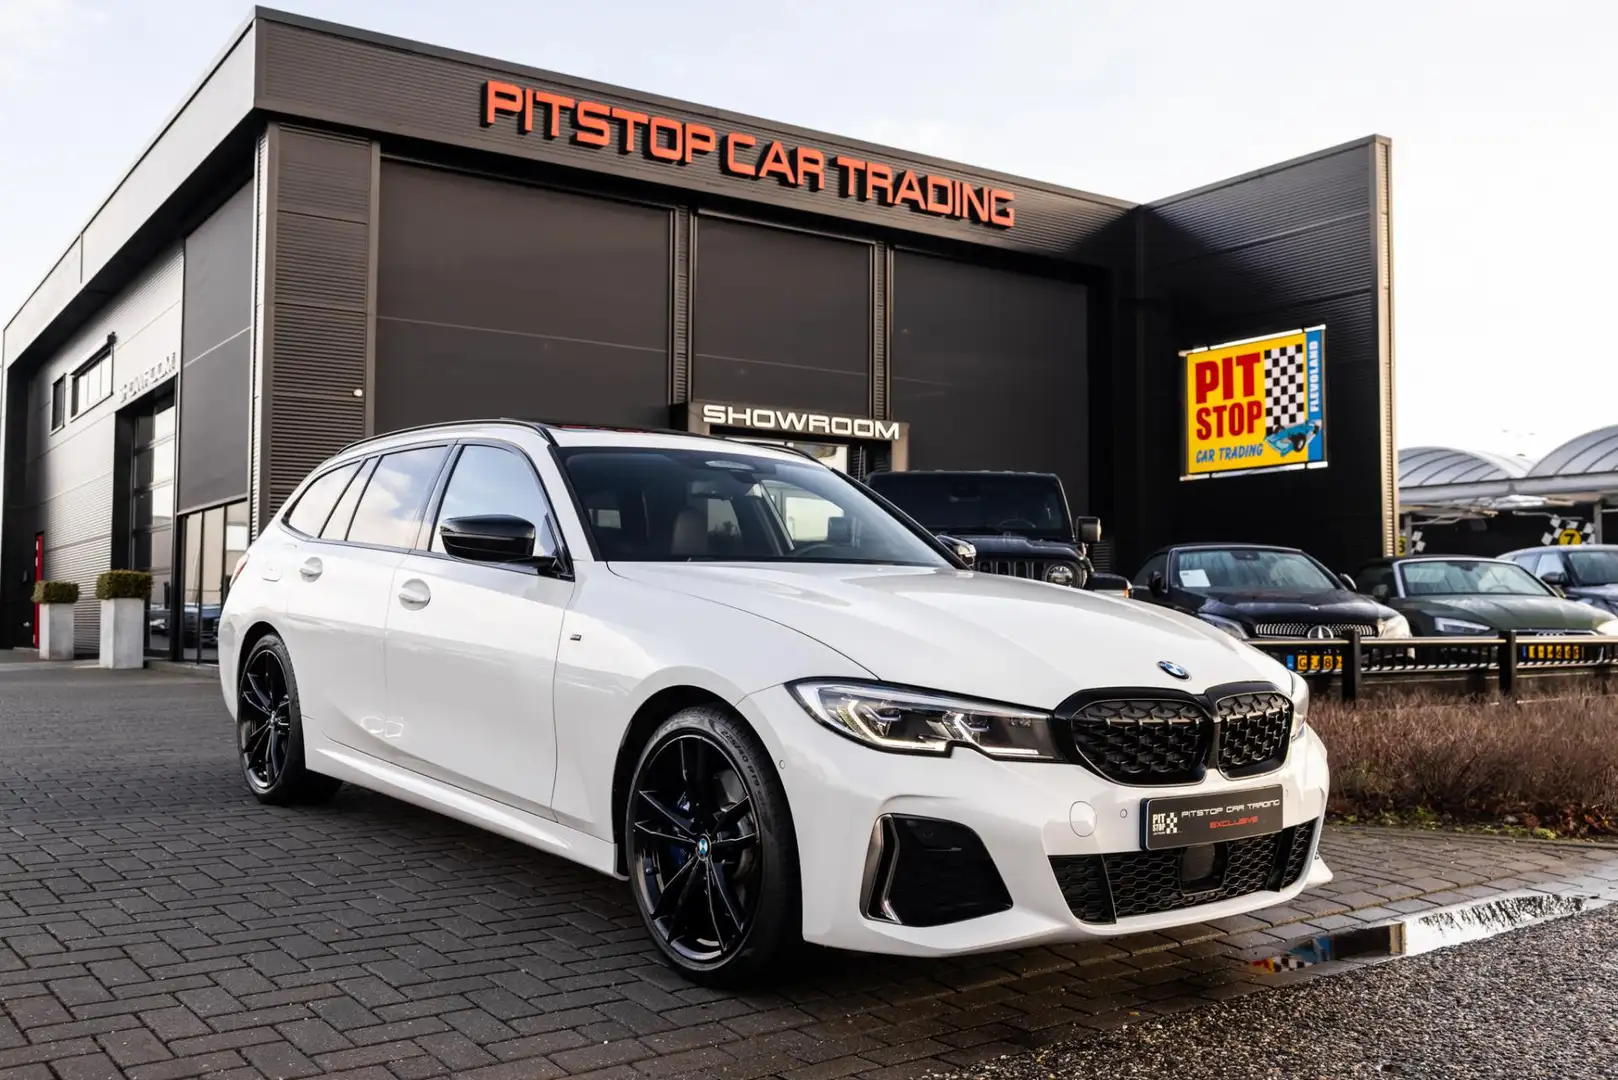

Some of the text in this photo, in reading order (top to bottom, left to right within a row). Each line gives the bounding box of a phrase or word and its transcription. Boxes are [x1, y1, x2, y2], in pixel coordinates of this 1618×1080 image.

[482, 80, 1015, 228] PITSTOP CAR TRADING
[1195, 352, 1261, 404] PIT
[1308, 340, 1320, 412] FLEVOLAND
[703, 404, 899, 440] SHOWROOM
[1196, 400, 1262, 440] STOP
[1196, 443, 1264, 463] CAR TRADING
[1564, 533, 1576, 545] 7
[1152, 813, 1166, 824] PIT
[1181, 799, 1280, 818] PITSTOP CAR TRADING
[1209, 816, 1258, 829] EXCLUSIVE
